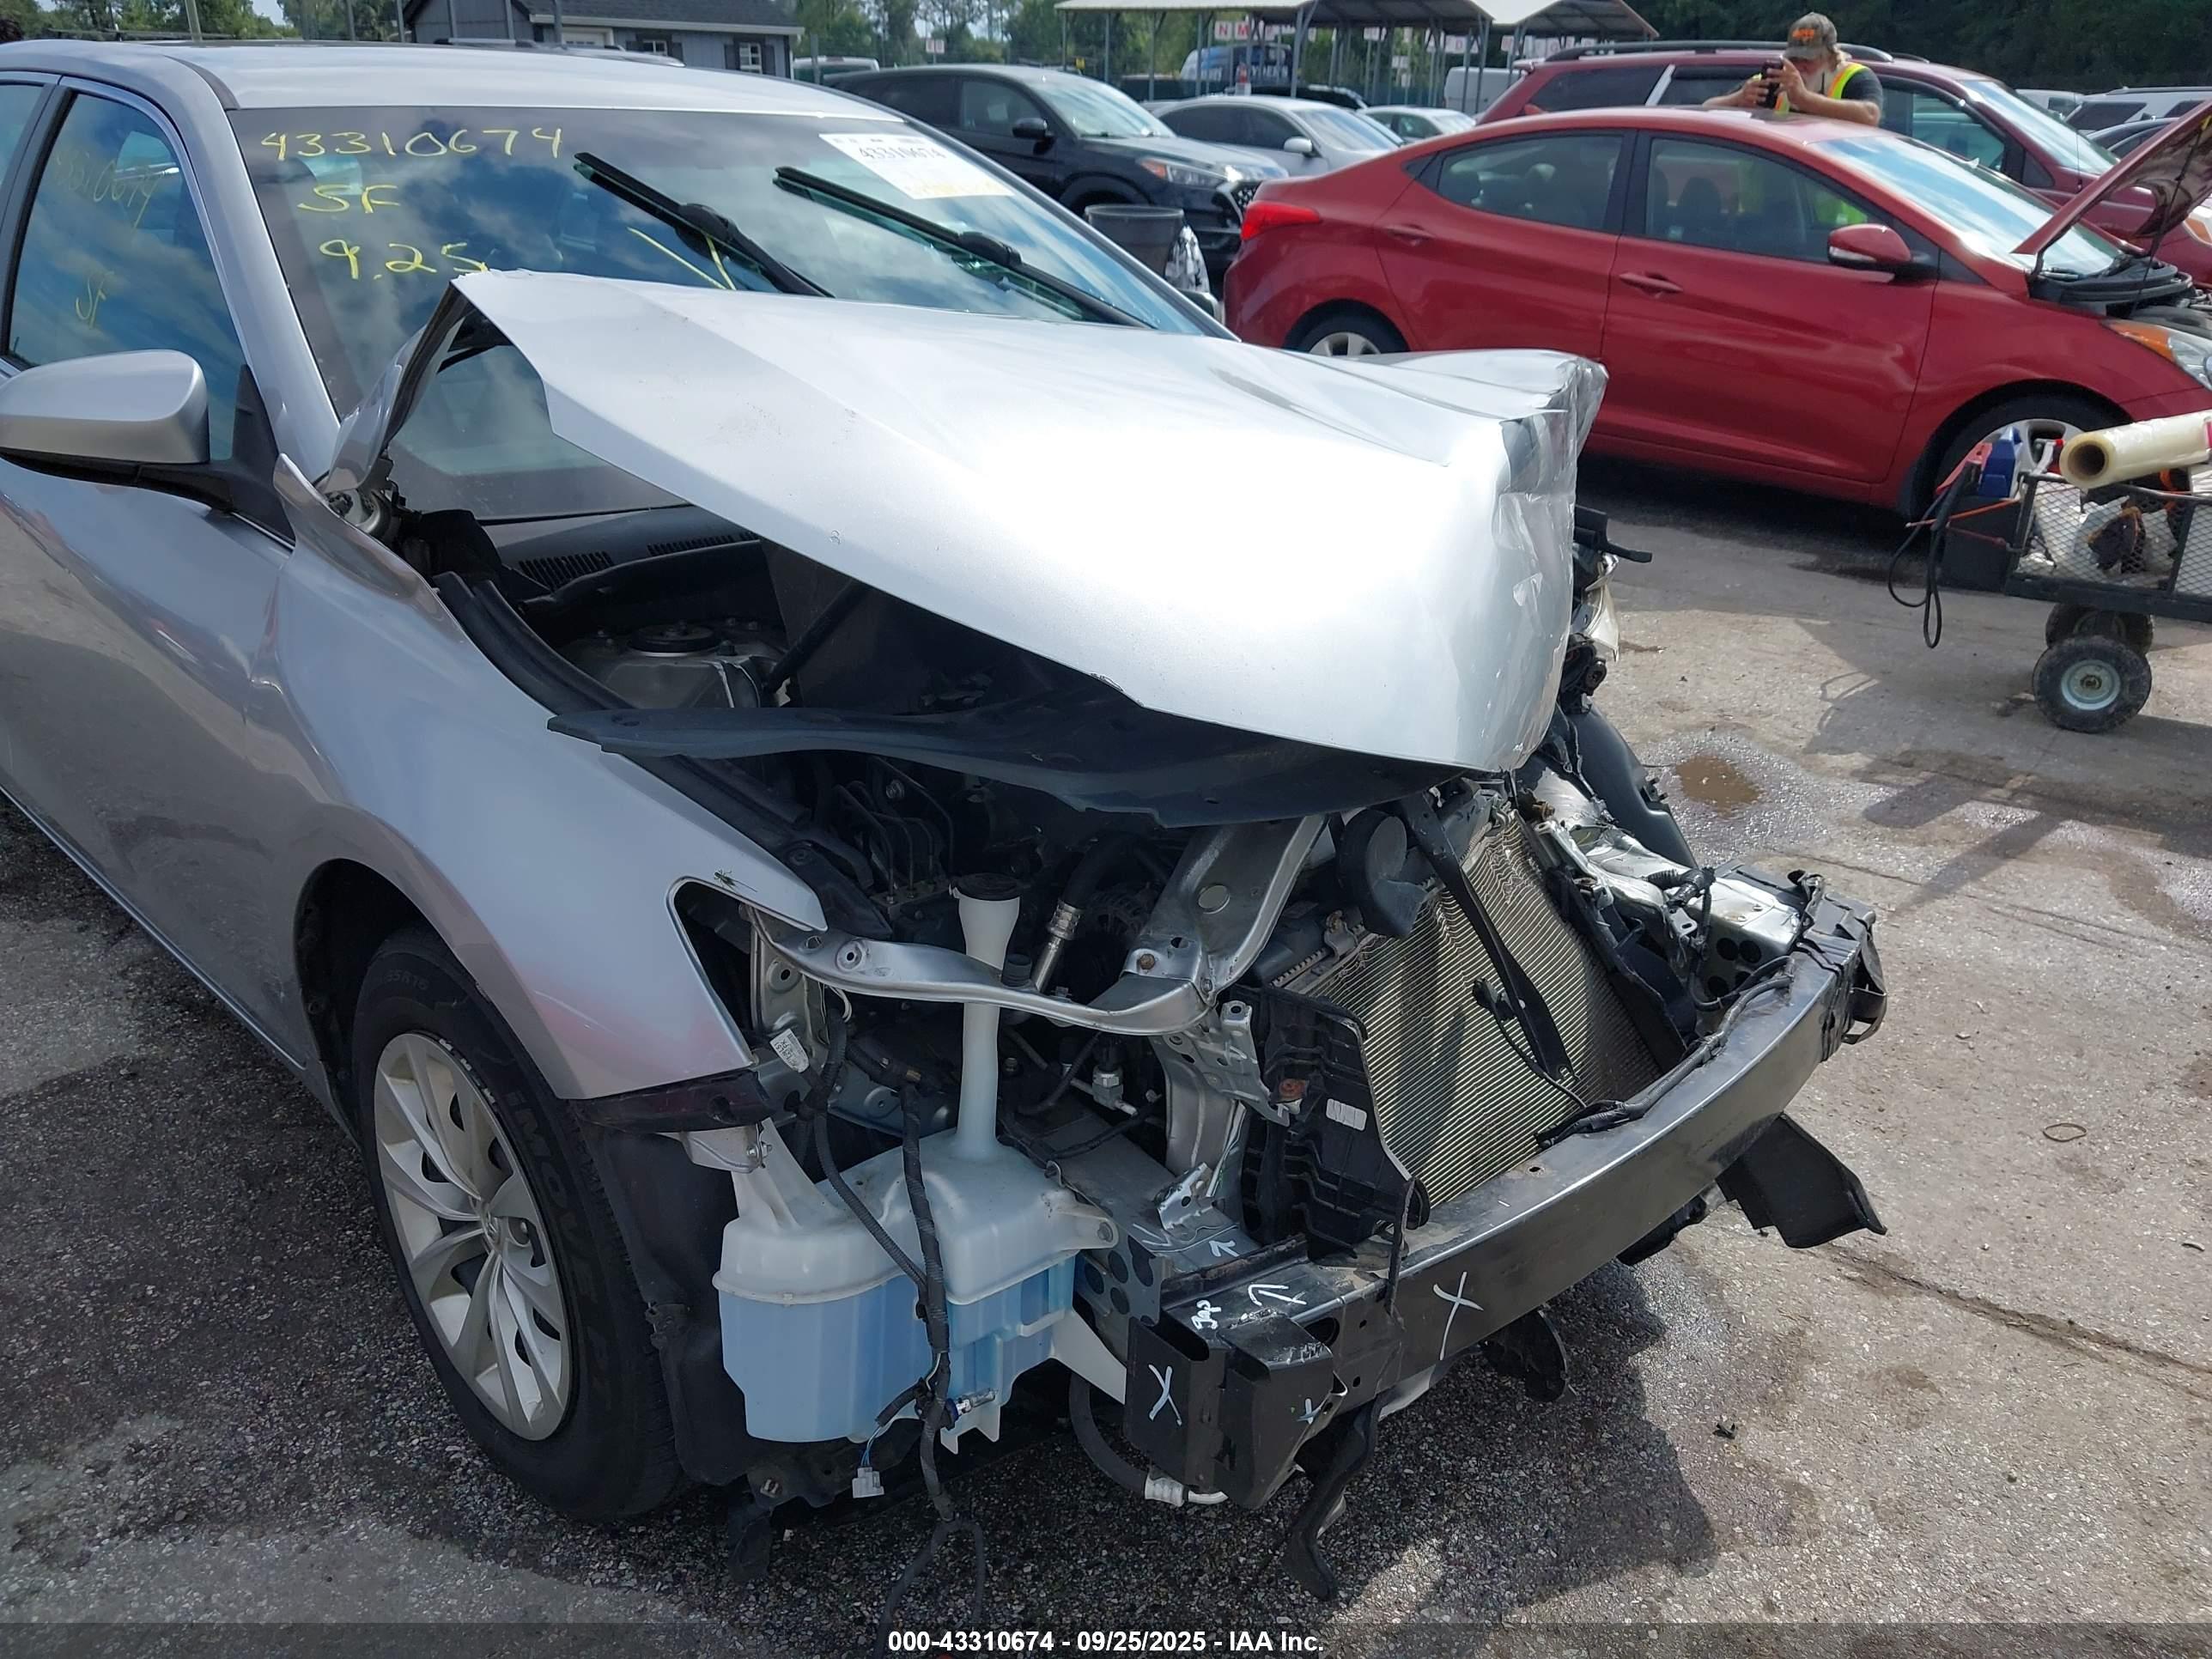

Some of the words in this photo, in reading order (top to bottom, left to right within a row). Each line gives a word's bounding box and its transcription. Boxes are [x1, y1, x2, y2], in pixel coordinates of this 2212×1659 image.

[261, 128, 562, 161] 43310674
[297, 184, 401, 213] SF
[319, 239, 489, 280] 9.25
